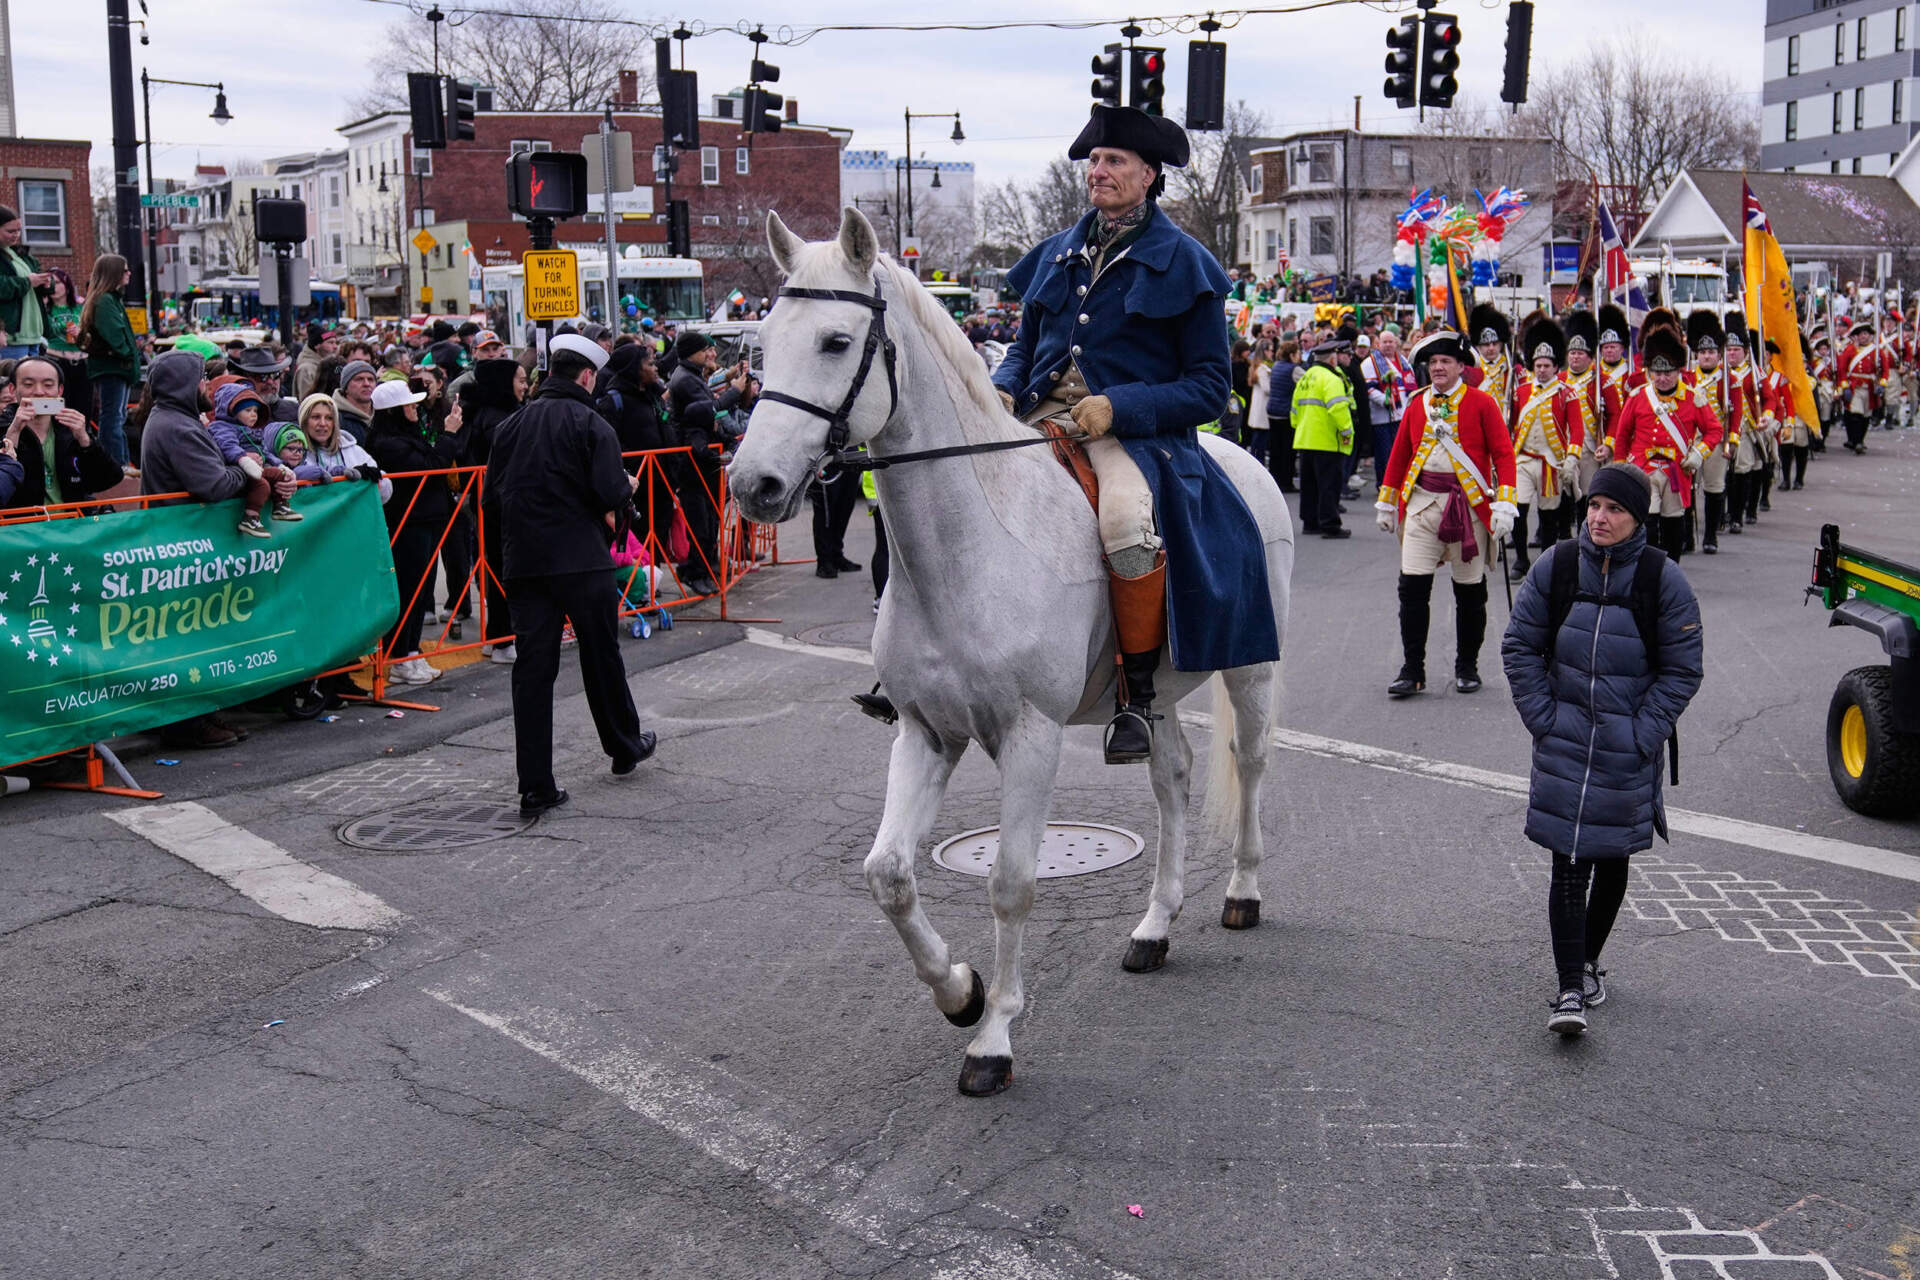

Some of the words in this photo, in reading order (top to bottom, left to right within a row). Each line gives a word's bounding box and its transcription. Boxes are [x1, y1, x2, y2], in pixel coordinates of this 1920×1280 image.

[151, 195, 191, 207] PREBLE
[537, 257, 566, 269] WATCH
[544, 272, 562, 283] FOR
[533, 286, 572, 299] TURNING
[532, 300, 575, 313] VEHICLES
[103, 546, 156, 567] SOUTH
[157, 538, 214, 560] BOSTON
[101, 572, 135, 600] St.
[140, 553, 247, 594] Patrick's
[248, 548, 289, 574] Day
[99, 581, 255, 650] Parade
[208, 660, 236, 677] 1776
[246, 650, 278, 670] 2026
[45, 680, 147, 714] EVACUATION
[150, 673, 178, 691] 250
